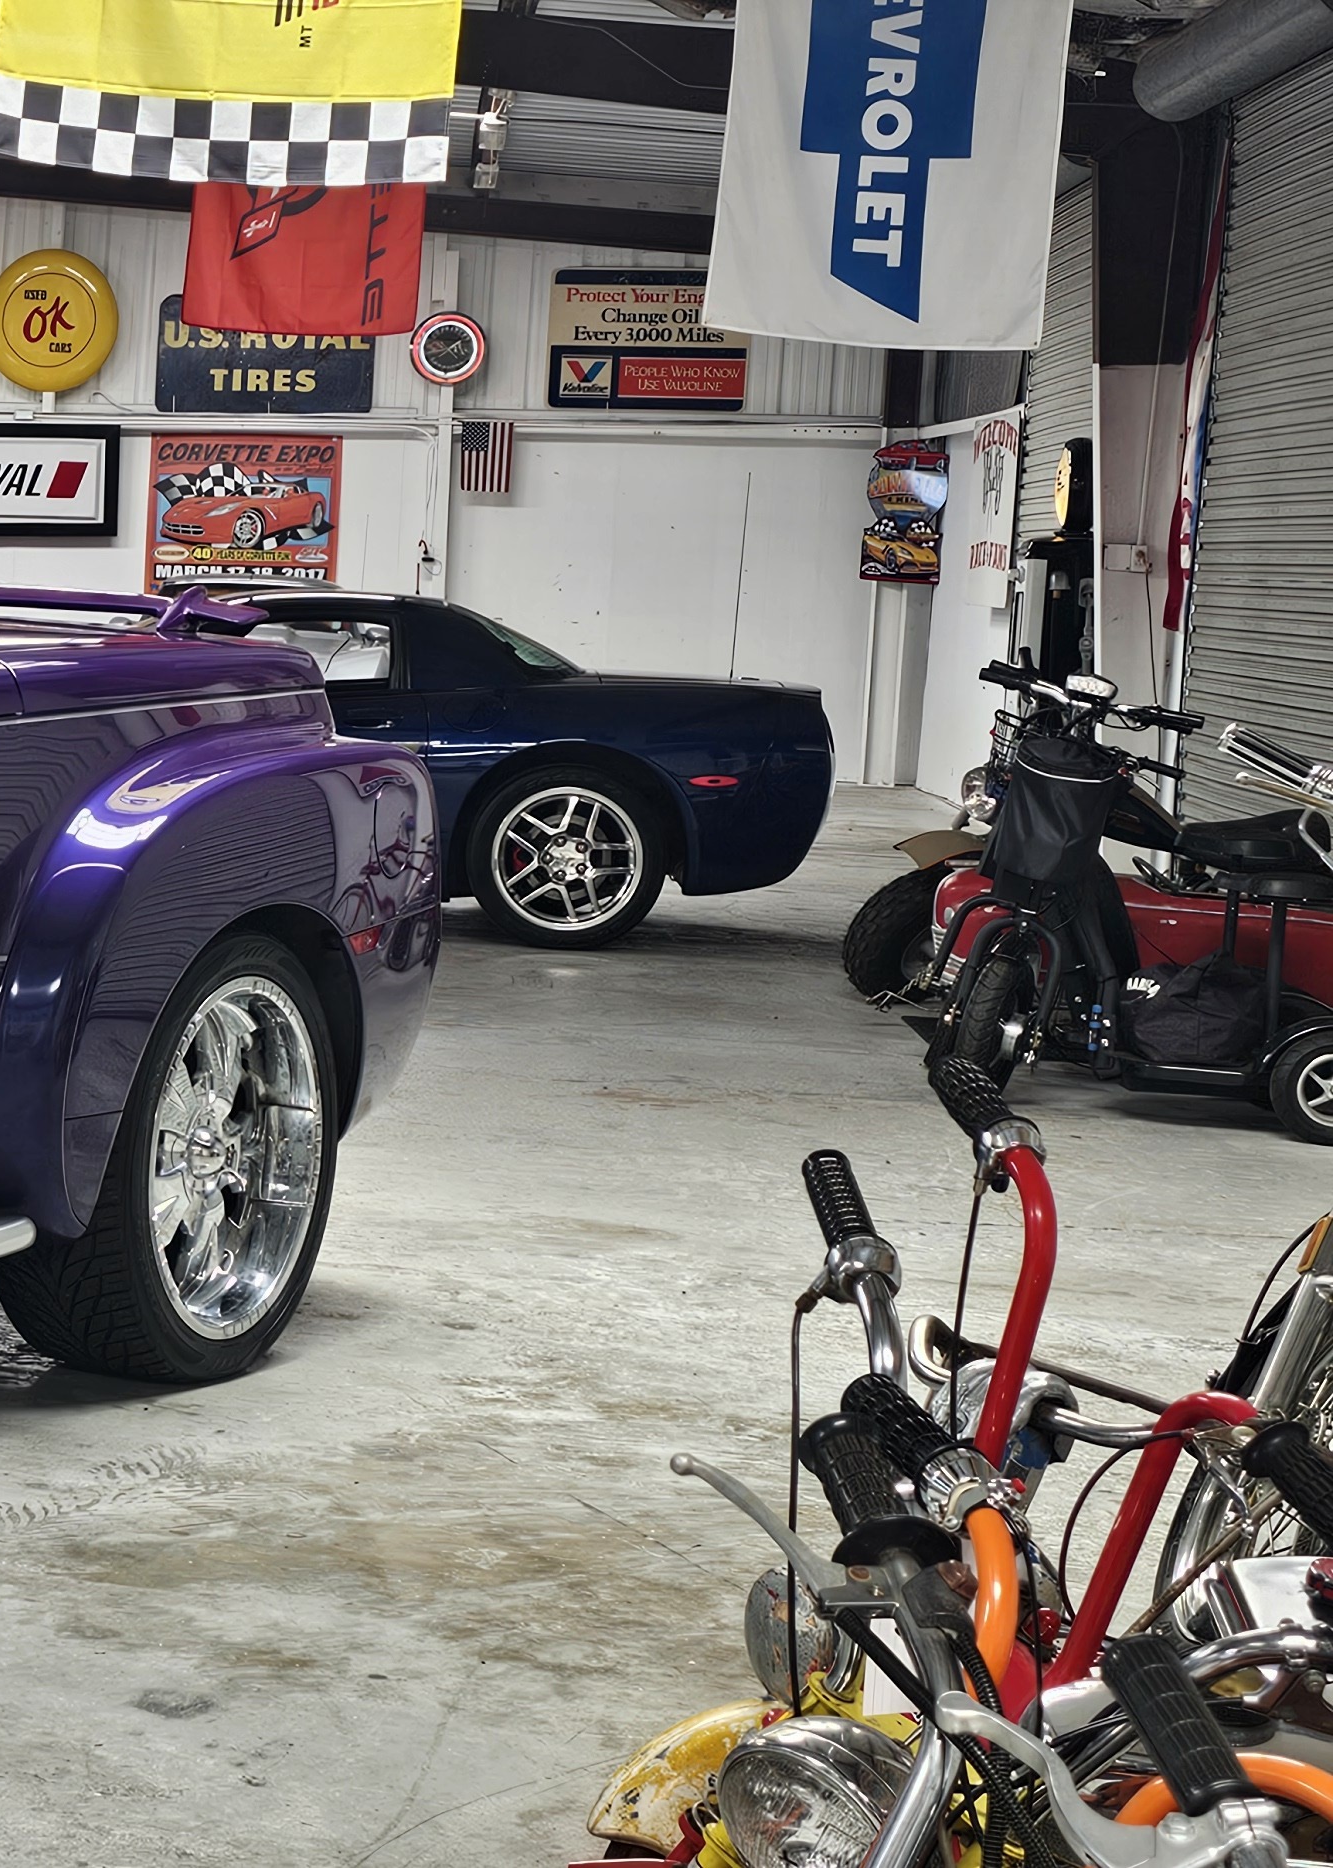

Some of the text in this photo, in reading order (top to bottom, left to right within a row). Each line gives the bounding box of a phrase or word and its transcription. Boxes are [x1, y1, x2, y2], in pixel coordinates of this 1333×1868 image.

[852, 0, 924, 267] VROLET
[566, 288, 706, 306] Protect Your Eng
[23, 296, 76, 343] OK
[601, 308, 699, 326] Change Oil
[164, 320, 230, 349] U.S.
[574, 326, 725, 345] Every 3,000 Miles
[49, 342, 73, 353] CARS
[209, 368, 317, 393] TIRES
[624, 365, 741, 379] PEOPLE WHO KNOW
[561, 382, 609, 394] Valvoline
[637, 379, 724, 392] USE VALVOLINE
[158, 443, 336, 464] CORVETTE EXPO
[192, 548, 212, 559] 40
